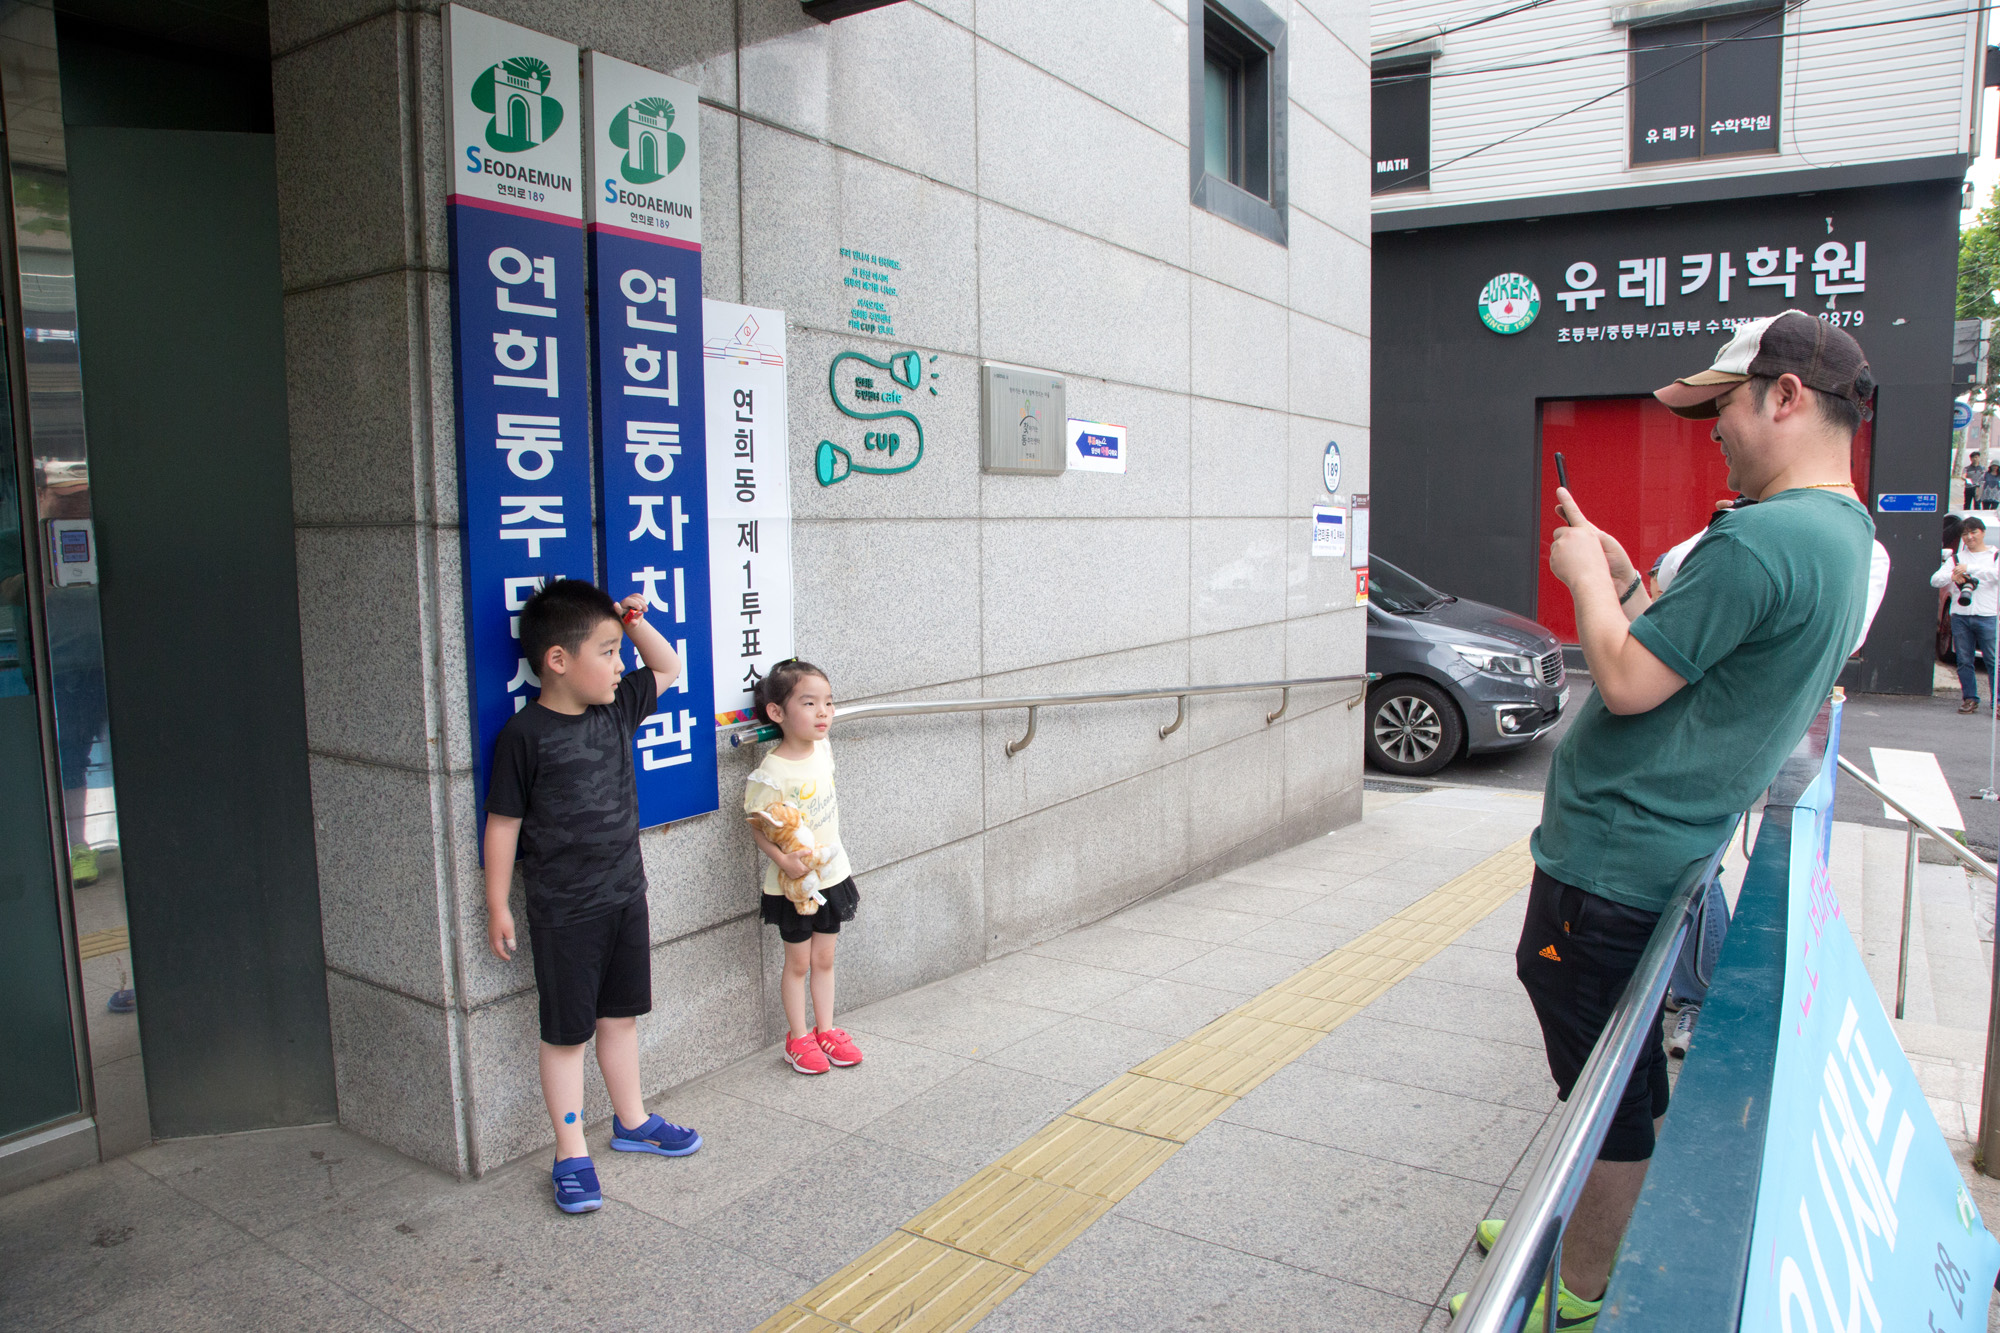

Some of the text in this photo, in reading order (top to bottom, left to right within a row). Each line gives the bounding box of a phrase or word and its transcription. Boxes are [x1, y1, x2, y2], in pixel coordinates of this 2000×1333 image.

[1646, 115, 1771, 144] 유레카 수학학원
[466, 145, 572, 192] SEODAEMUN
[1376, 158, 1409, 173] MATH
[604, 178, 692, 219] SEODAEMUN
[1479, 272, 1540, 305] EUREKA
[1556, 241, 1867, 312] 유레카학원
[1483, 310, 1535, 332] SINCE 1997
[1557, 320, 1700, 342] 초등부/중등부/고등부
[881, 389, 903, 404] cafe
[733, 388, 757, 503] 연희동
[1327, 462, 1339, 476] 189
[1538, 950, 1562, 962] adidas
